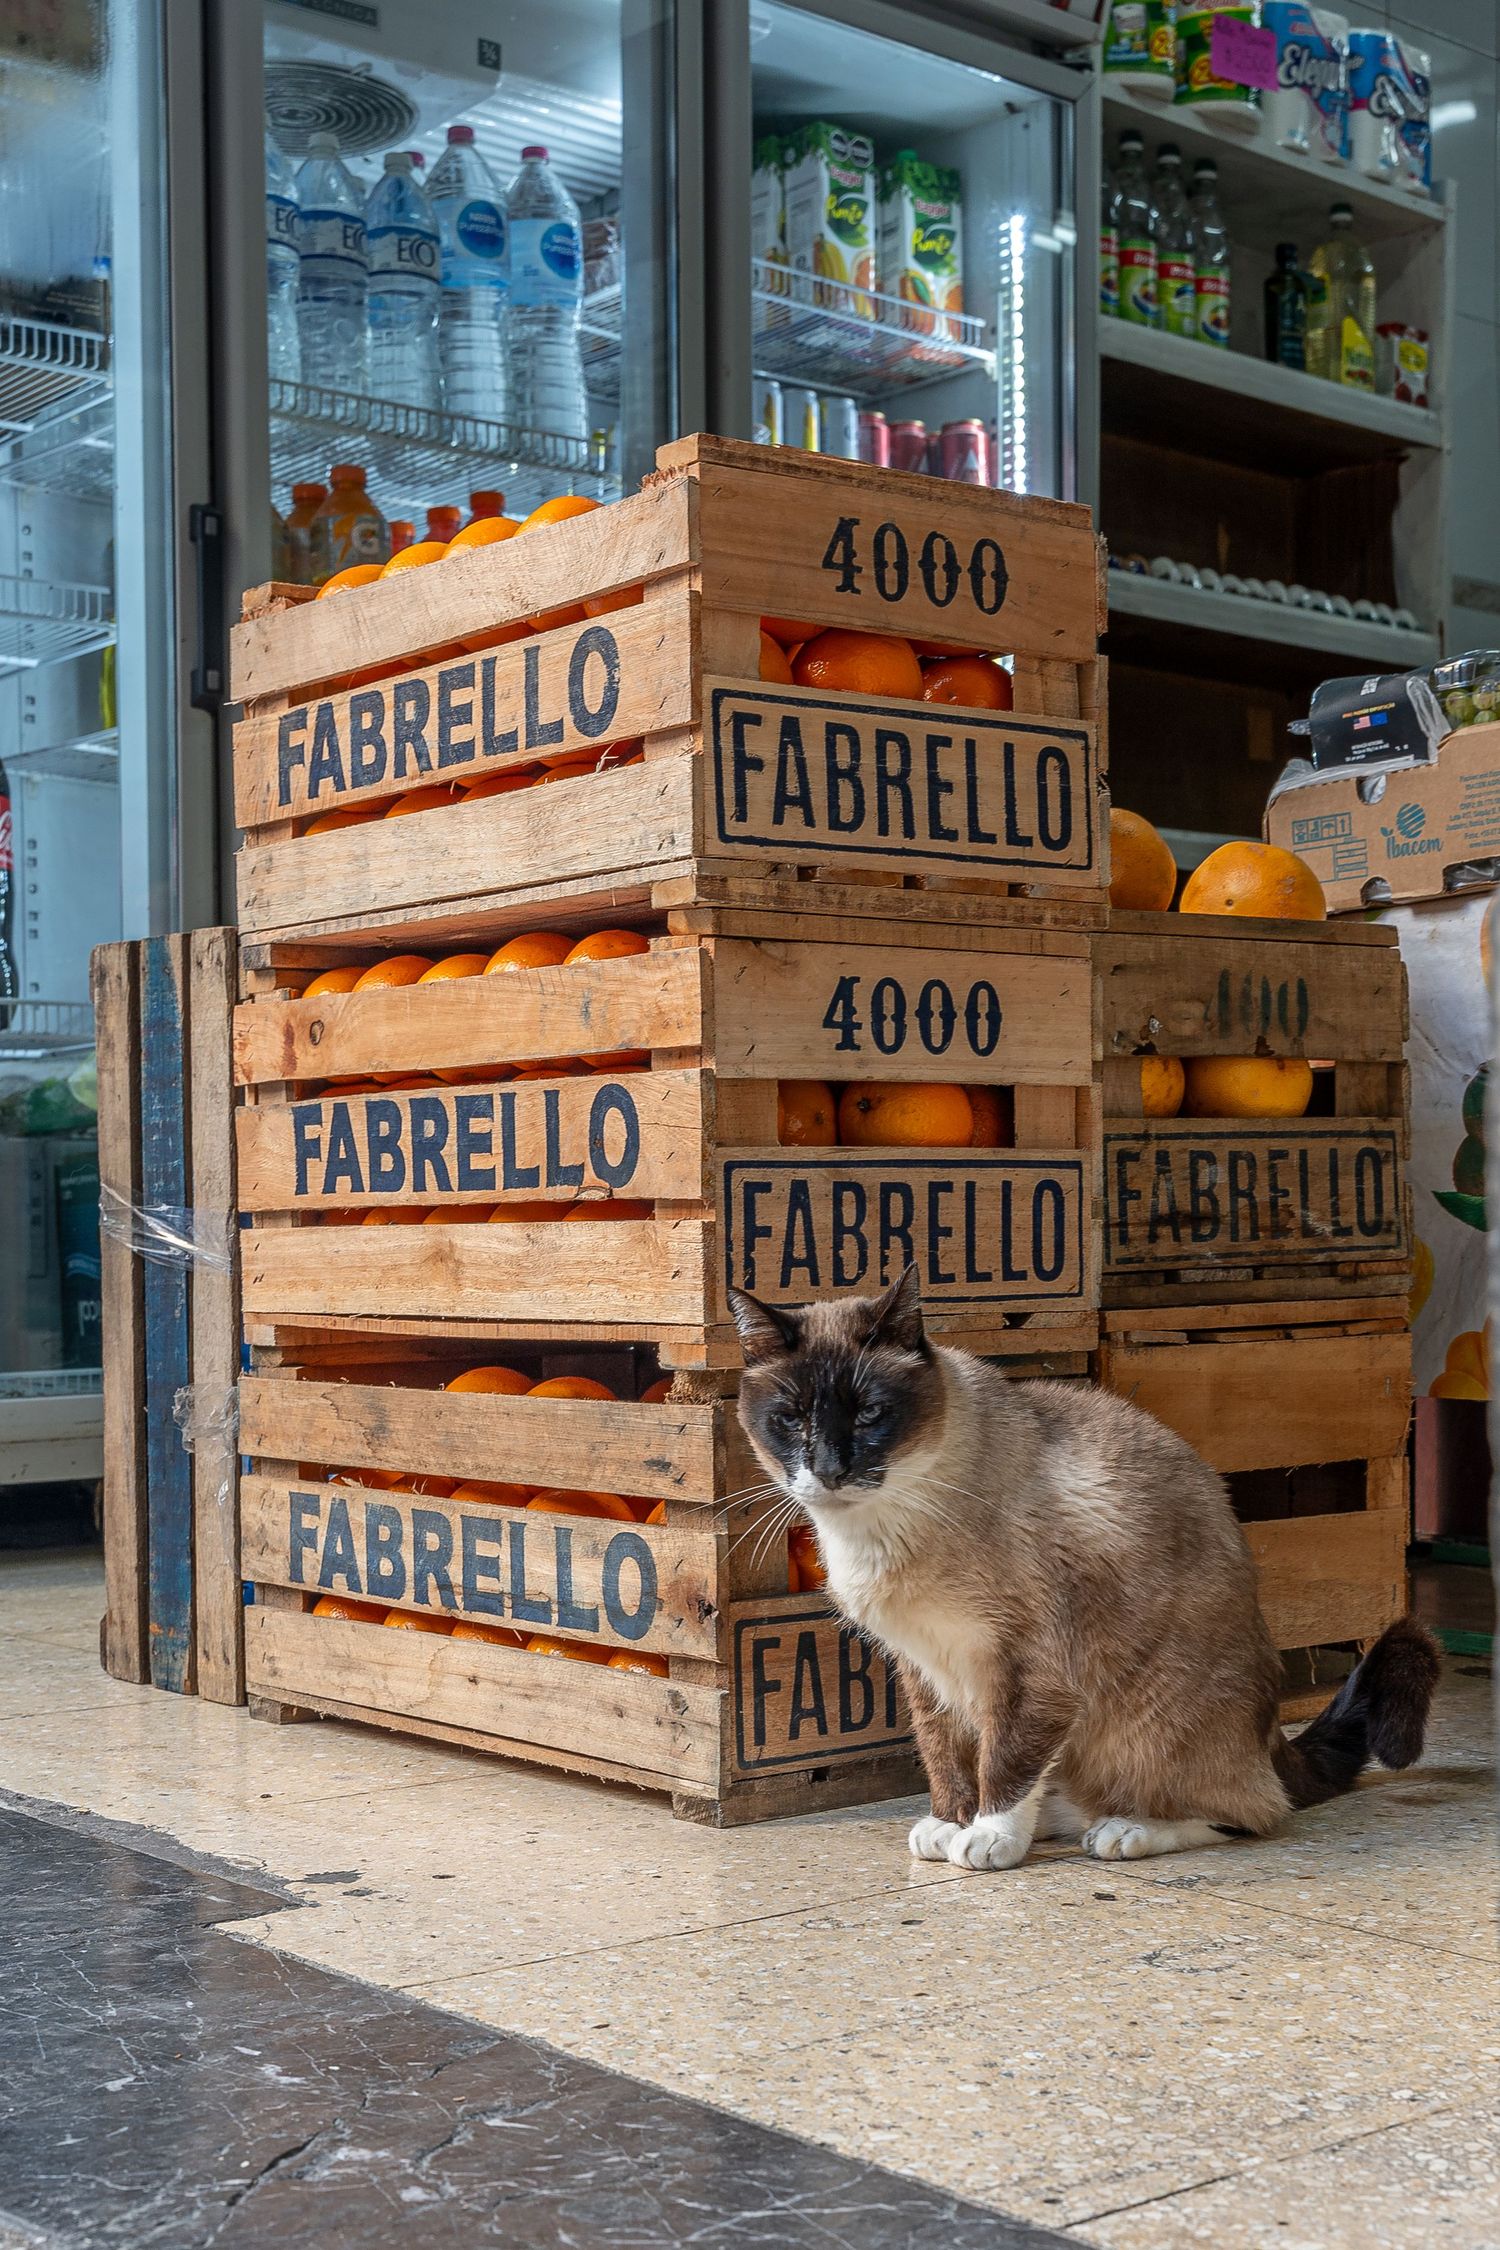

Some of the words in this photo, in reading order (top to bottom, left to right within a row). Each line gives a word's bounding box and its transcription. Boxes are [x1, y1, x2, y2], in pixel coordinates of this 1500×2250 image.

[822, 516, 1010, 616] 4000
[278, 625, 620, 808] FABRELLO
[730, 710, 1073, 852] FABRELLO
[822, 975, 1003, 1058] 4000
[291, 1083, 640, 1196] FABRELLO
[742, 1178, 1066, 1291] FABRELLO
[1114, 1146, 1384, 1247] FABRELLO
[288, 1490, 660, 1642] FABRELLO
